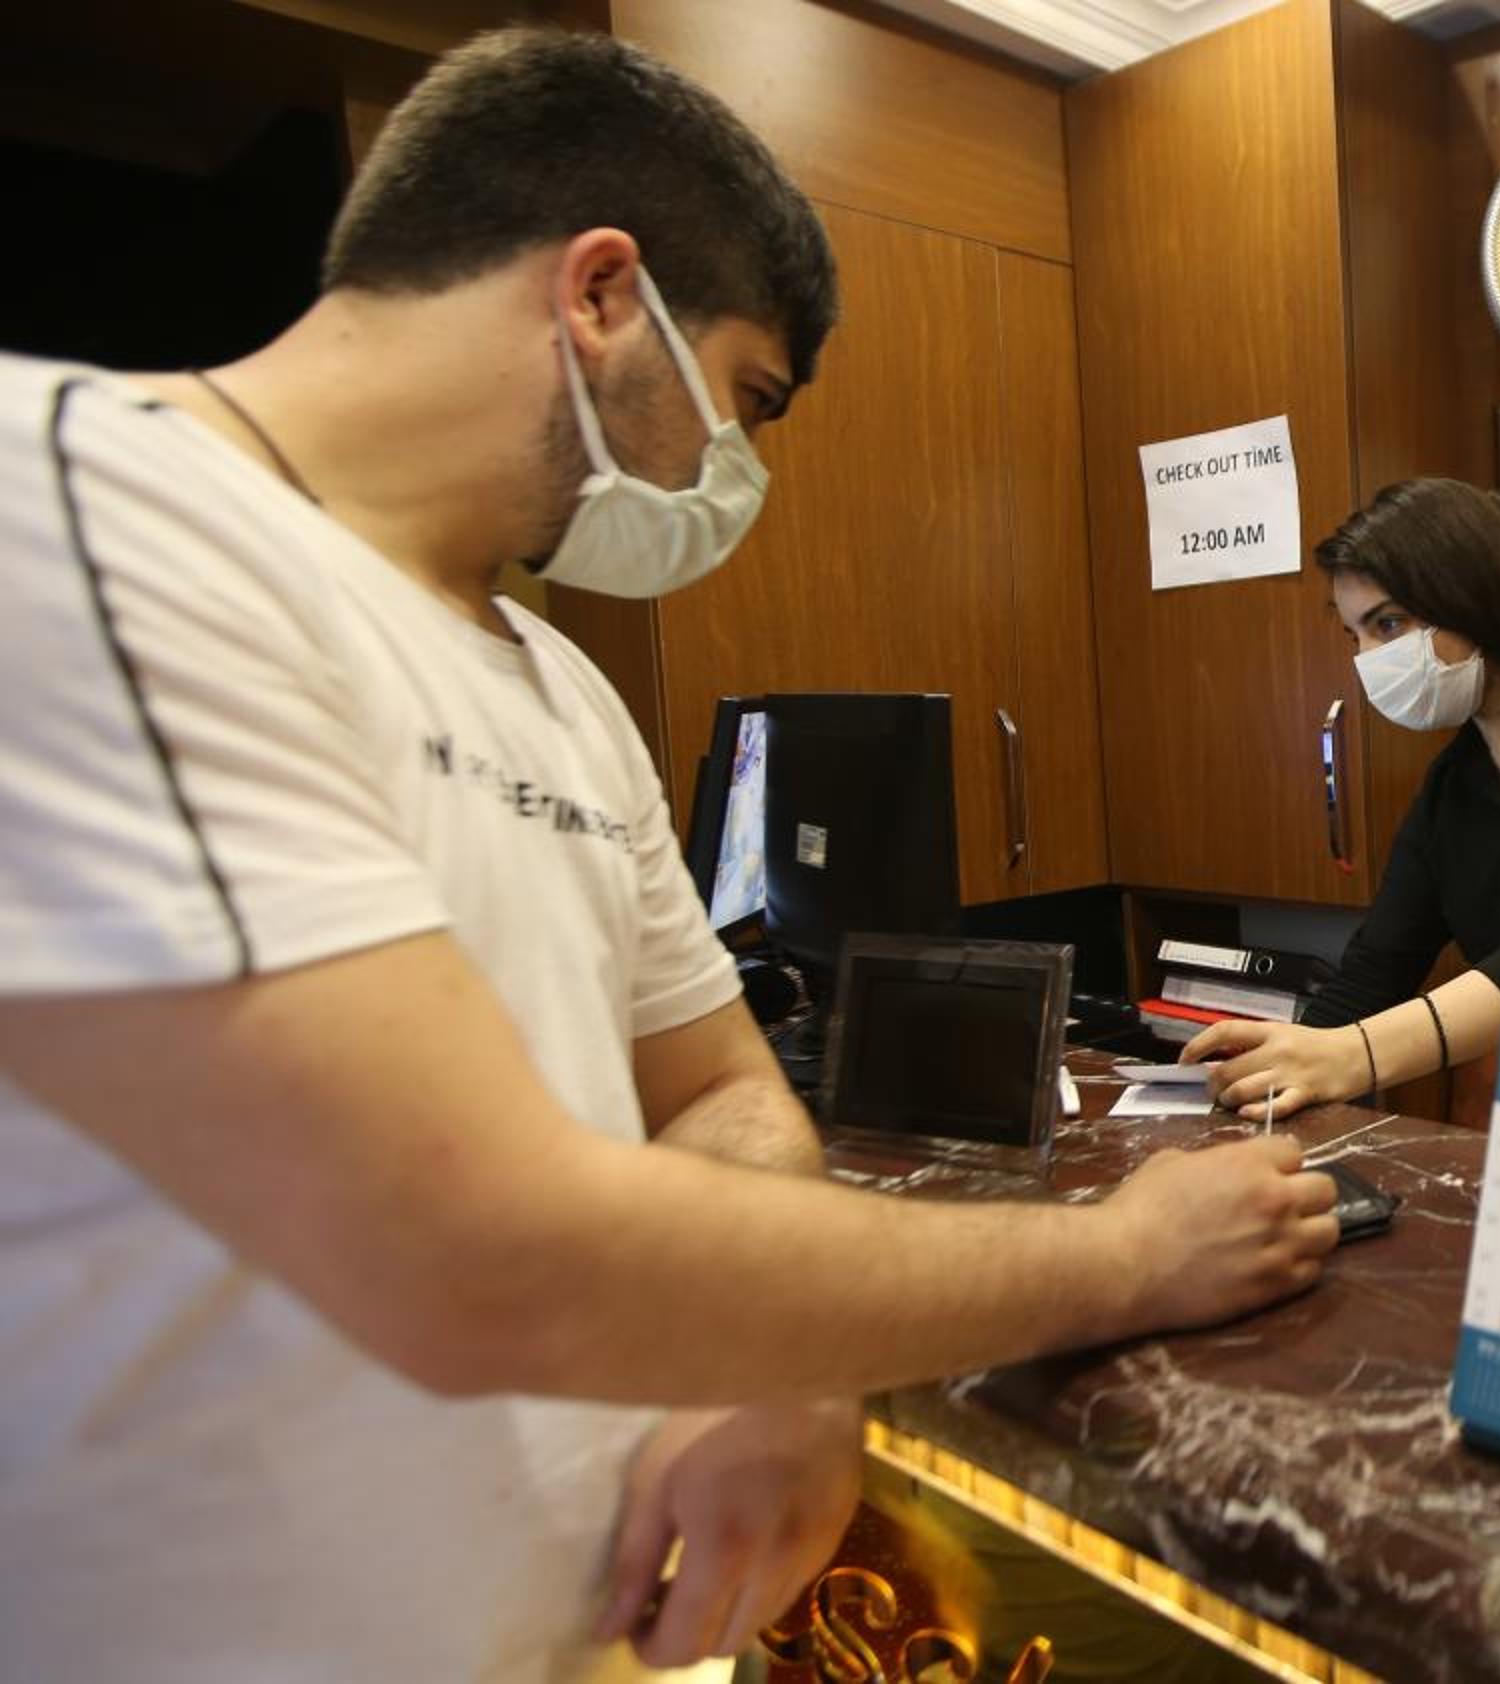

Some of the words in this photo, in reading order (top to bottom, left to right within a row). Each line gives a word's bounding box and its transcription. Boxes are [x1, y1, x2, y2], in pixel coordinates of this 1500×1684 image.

[1156, 460, 1203, 485] CHECK
[1207, 453, 1239, 476] OUT
[1180, 528, 1228, 555] 12:00
[1233, 522, 1265, 547] AM
